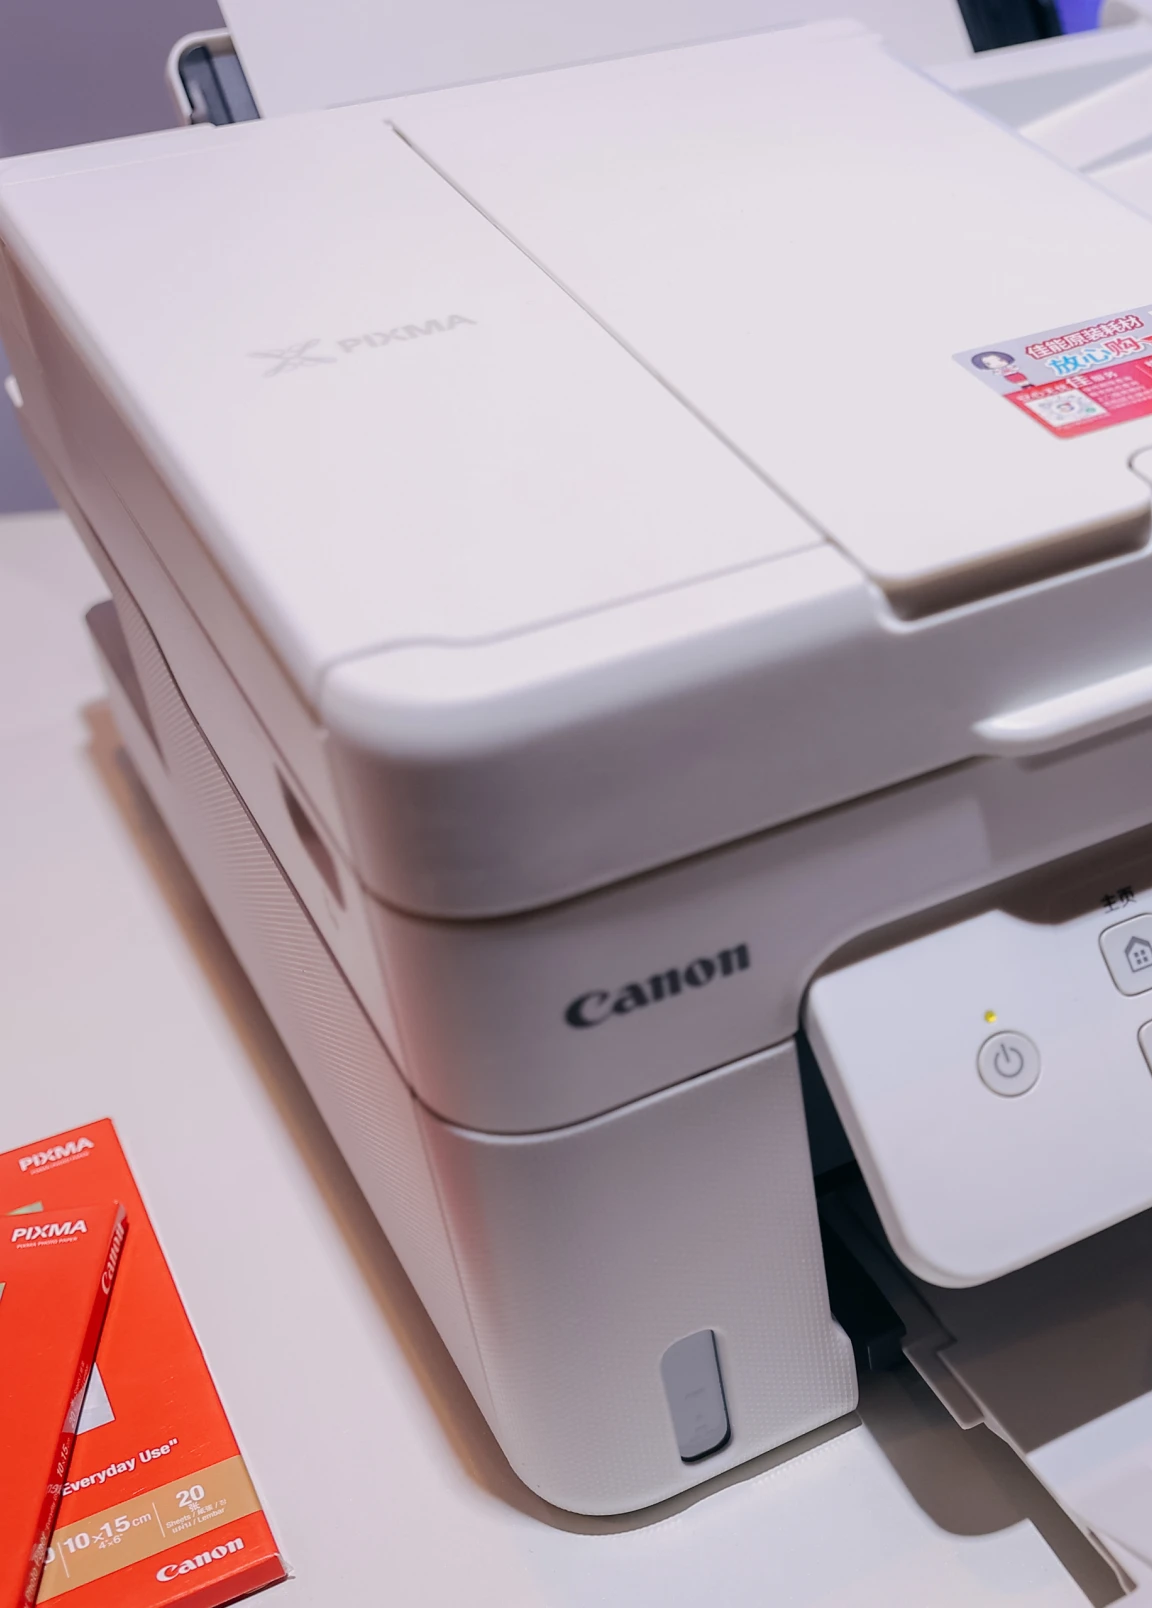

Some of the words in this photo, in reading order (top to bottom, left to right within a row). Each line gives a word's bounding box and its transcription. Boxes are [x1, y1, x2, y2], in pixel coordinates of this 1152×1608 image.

[336, 314, 478, 354] PIXMA
[1026, 315, 1144, 359] 佳能原装耗材
[1048, 336, 1141, 376] 放心购
[1101, 885, 1137, 914] 主页
[564, 942, 751, 1030] Canon
[18, 1137, 95, 1172] PIXMA
[11, 1219, 88, 1243] PIXMA
[101, 1222, 126, 1295] Canon
[61, 1458, 136, 1497] Everyday
[176, 1484, 205, 1508] 20
[165, 1514, 191, 1529] Sheets
[197, 1508, 225, 1523] Lembar
[156, 1537, 245, 1583] Canon
